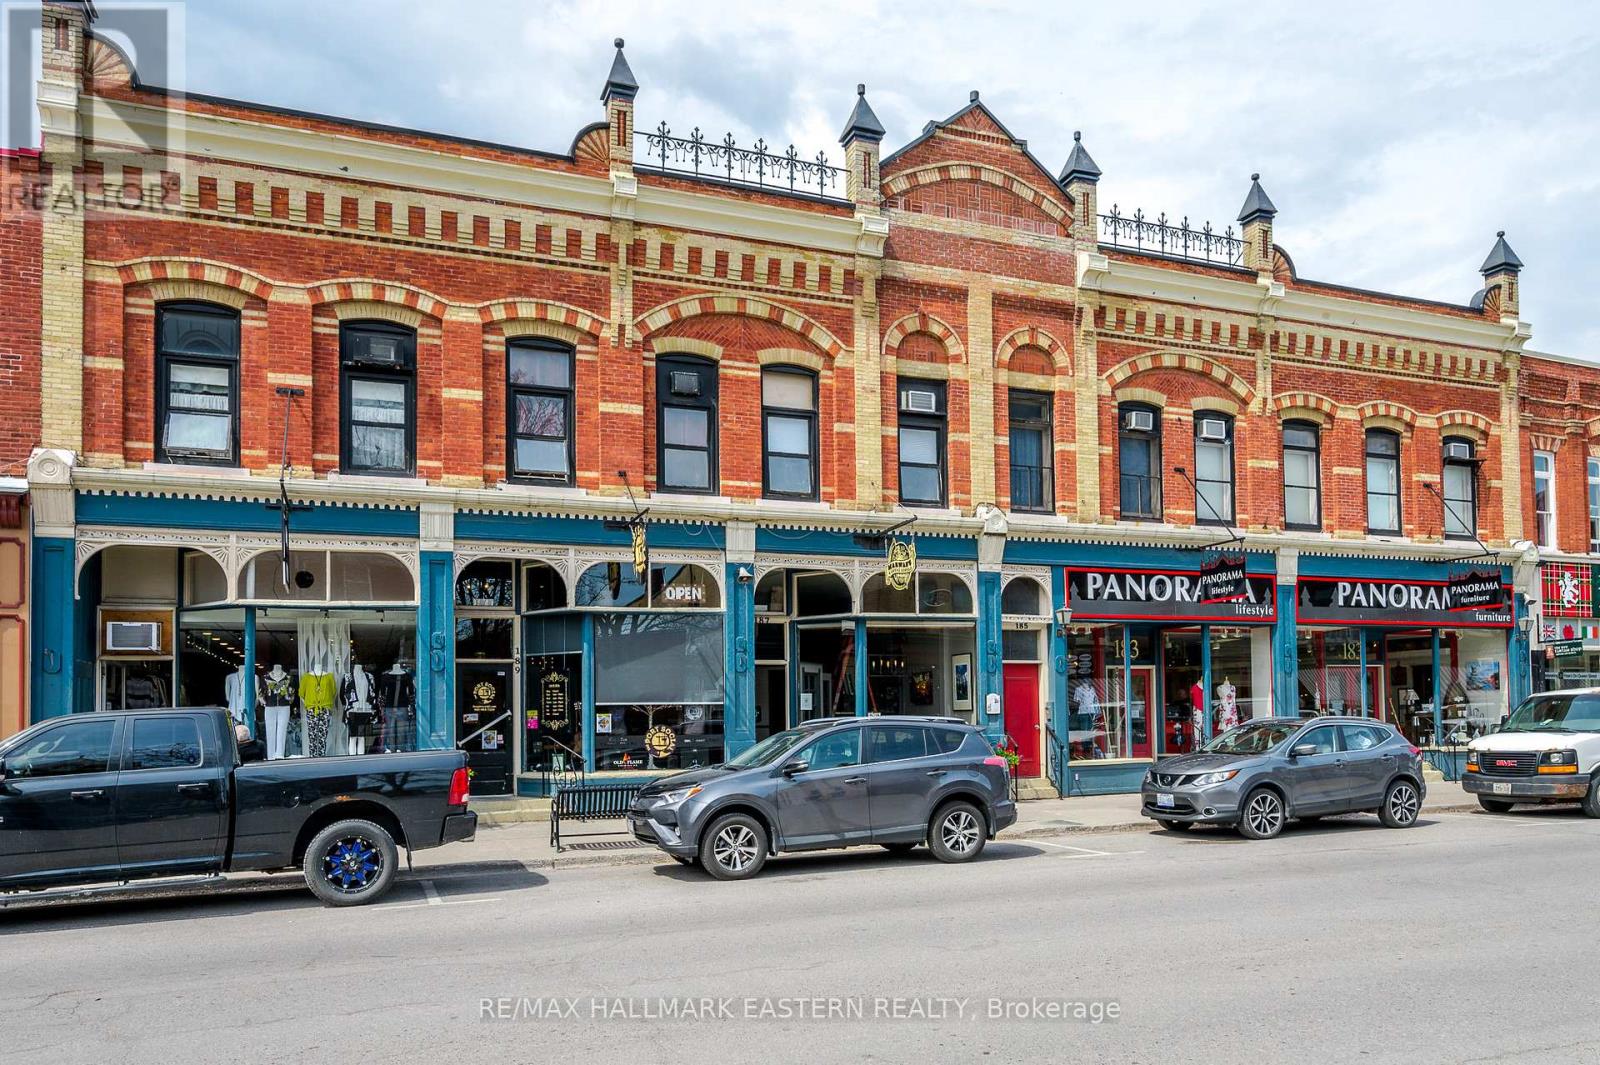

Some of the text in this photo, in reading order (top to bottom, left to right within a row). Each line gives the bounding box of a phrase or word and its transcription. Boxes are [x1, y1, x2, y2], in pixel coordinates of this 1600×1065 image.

[1202, 569, 1244, 585] PANORAMA
[665, 586, 702, 600] OPEN
[1211, 584, 1234, 595] lifestyle
[1451, 581, 1499, 595] PANORAMA
[1461, 594, 1490, 604] furniture
[1235, 604, 1274, 617] lifestyle
[1475, 611, 1511, 622] furniture
[1015, 622, 1029, 630] 185
[644, 726, 676, 751] PORT SOCIAL
